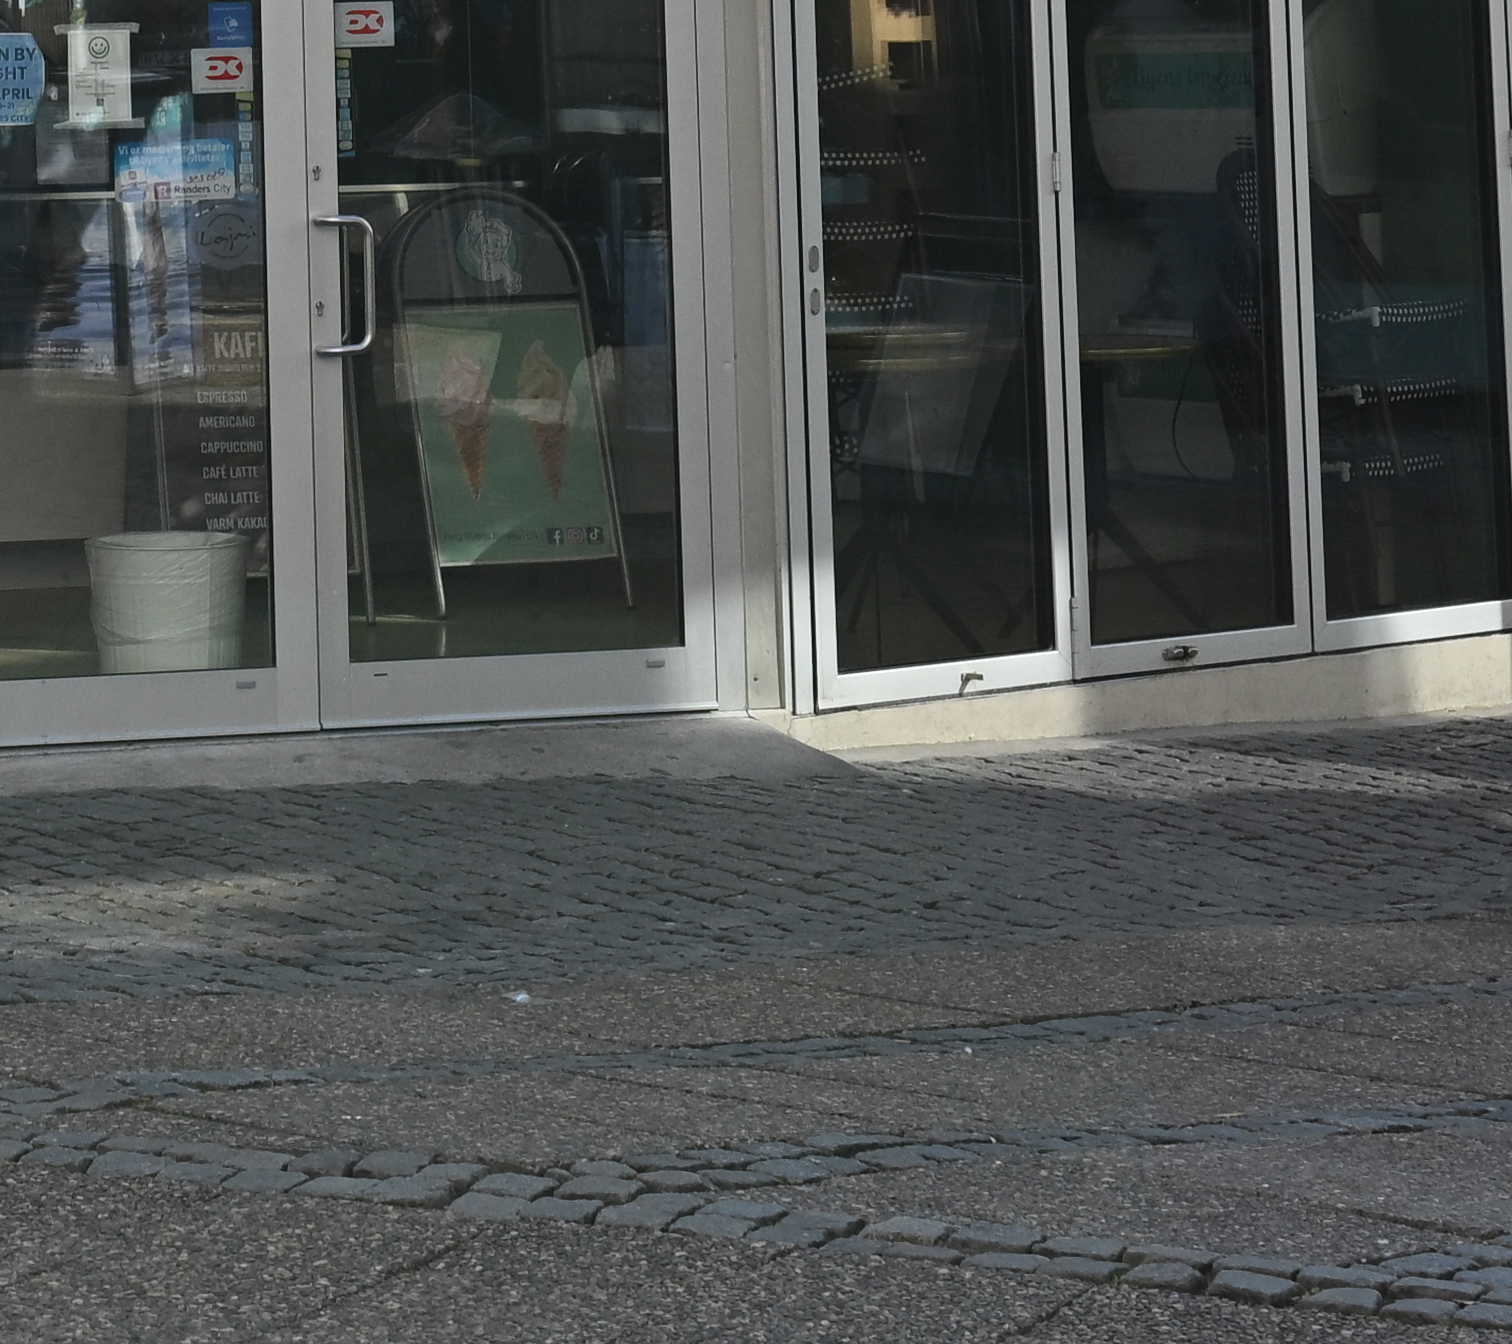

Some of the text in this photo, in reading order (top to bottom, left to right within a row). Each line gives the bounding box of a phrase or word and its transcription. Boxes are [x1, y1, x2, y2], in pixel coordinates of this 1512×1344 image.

[14, 47, 37, 61] BY
[174, 183, 232, 195] Randers City
[213, 332, 264, 359] KAF
[197, 391, 248, 404] ESPRESSO
[199, 415, 256, 429] AMERICANO
[201, 440, 264, 454] CAPPUCCINO
[202, 464, 259, 479] CAFÉ LATTE
[204, 491, 261, 505] CHAI LATTE
[206, 516, 267, 530] VARM KAKA
